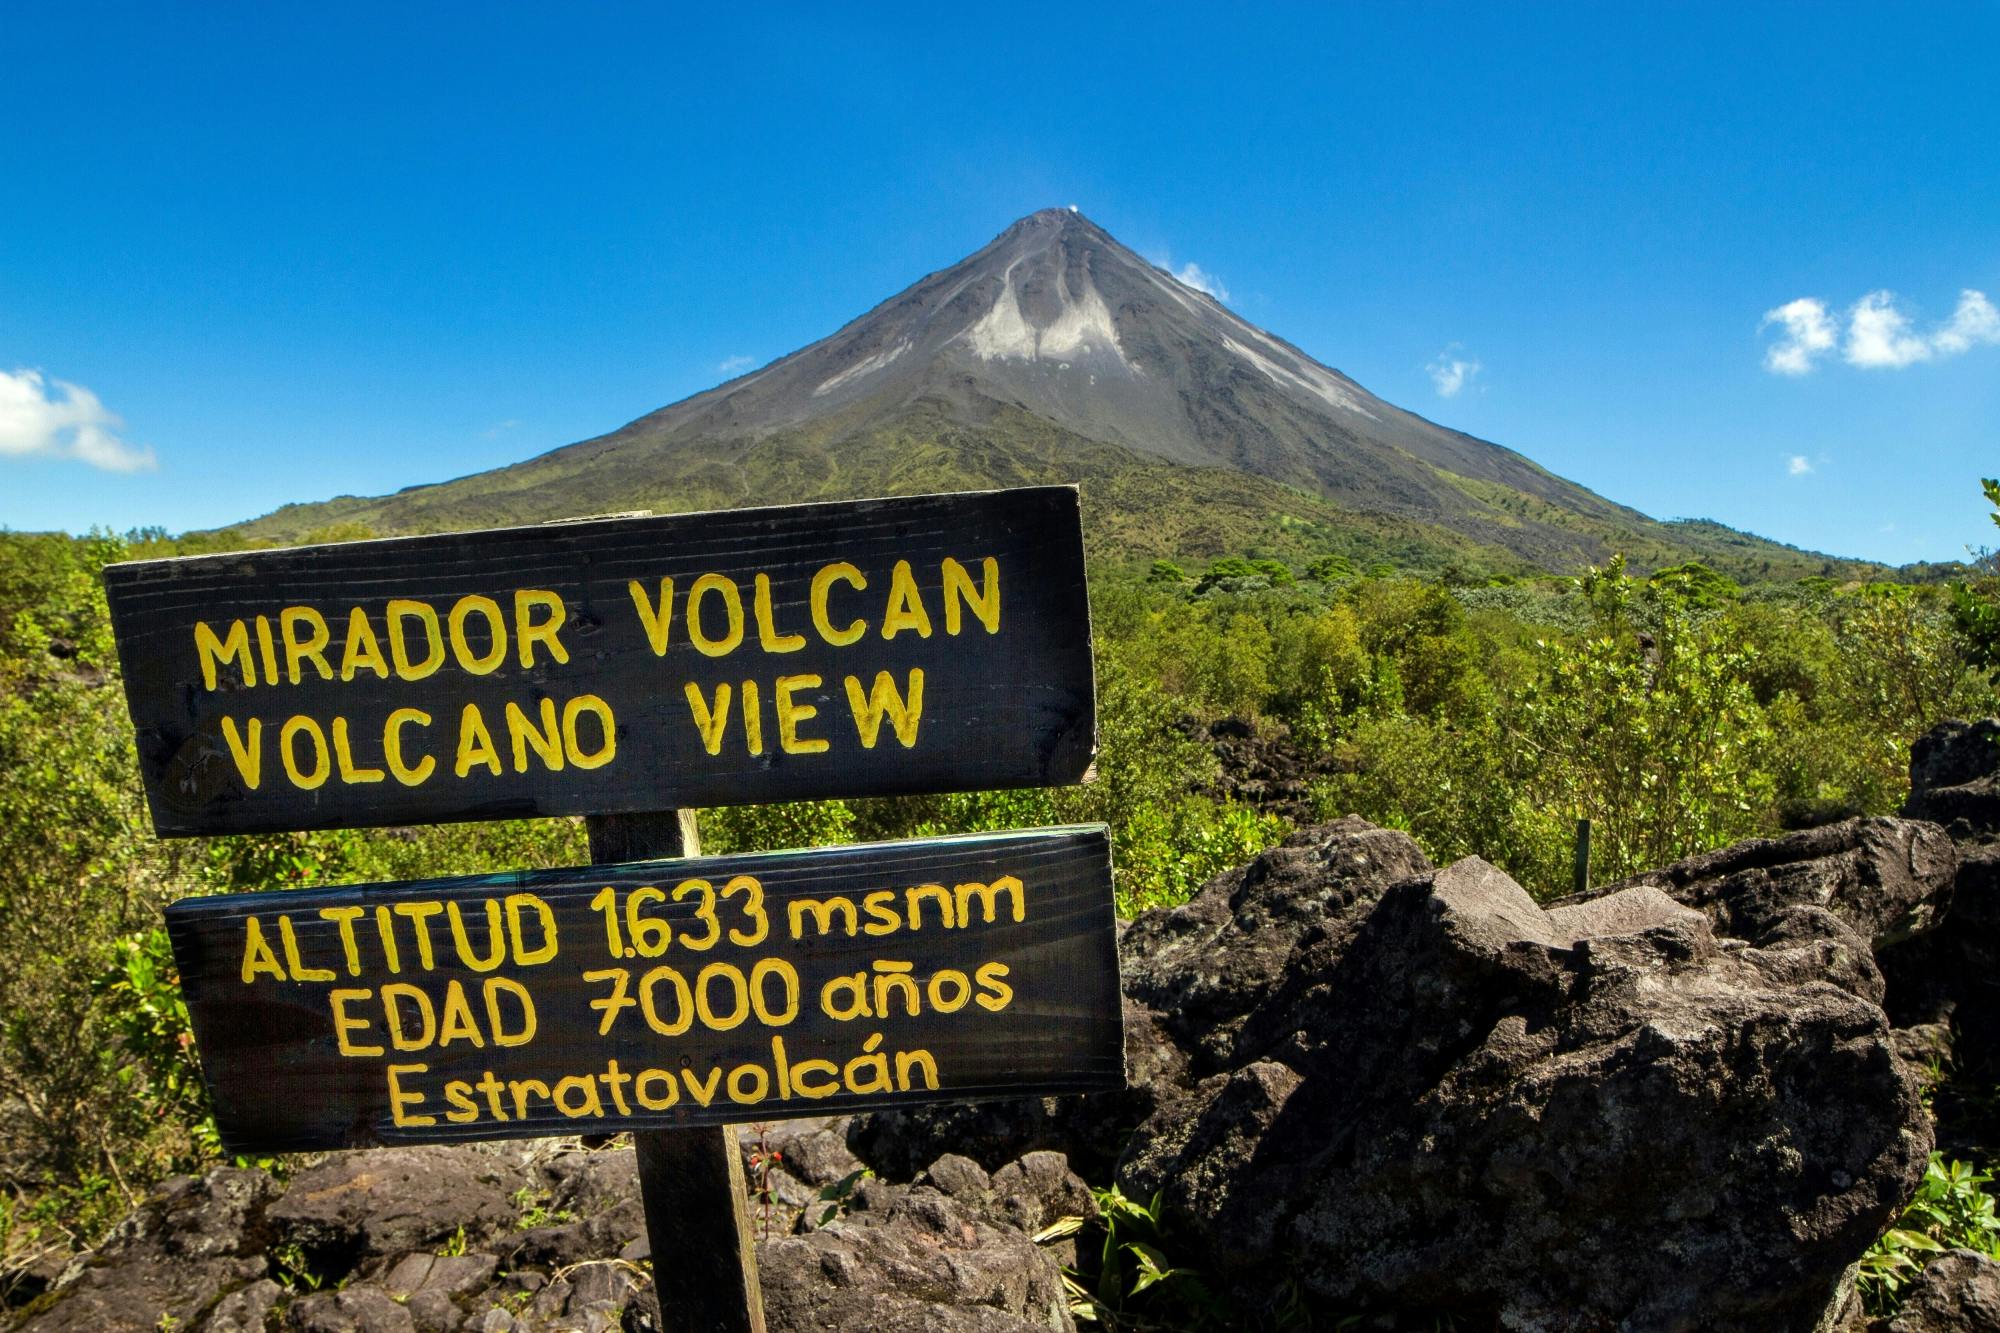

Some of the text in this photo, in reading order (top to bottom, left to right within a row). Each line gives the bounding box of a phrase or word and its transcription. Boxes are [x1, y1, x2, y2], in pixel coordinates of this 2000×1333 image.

[195, 557, 1001, 692] MIRADOR VOLCAN
[221, 668, 925, 790] VOLCANO VIEW
[242, 874, 1026, 984] ALTITUD 1.633 msnm
[328, 976, 538, 1058] EDAD
[583, 957, 801, 1038] 7000
[387, 1033, 941, 1129] Estratovolcán
